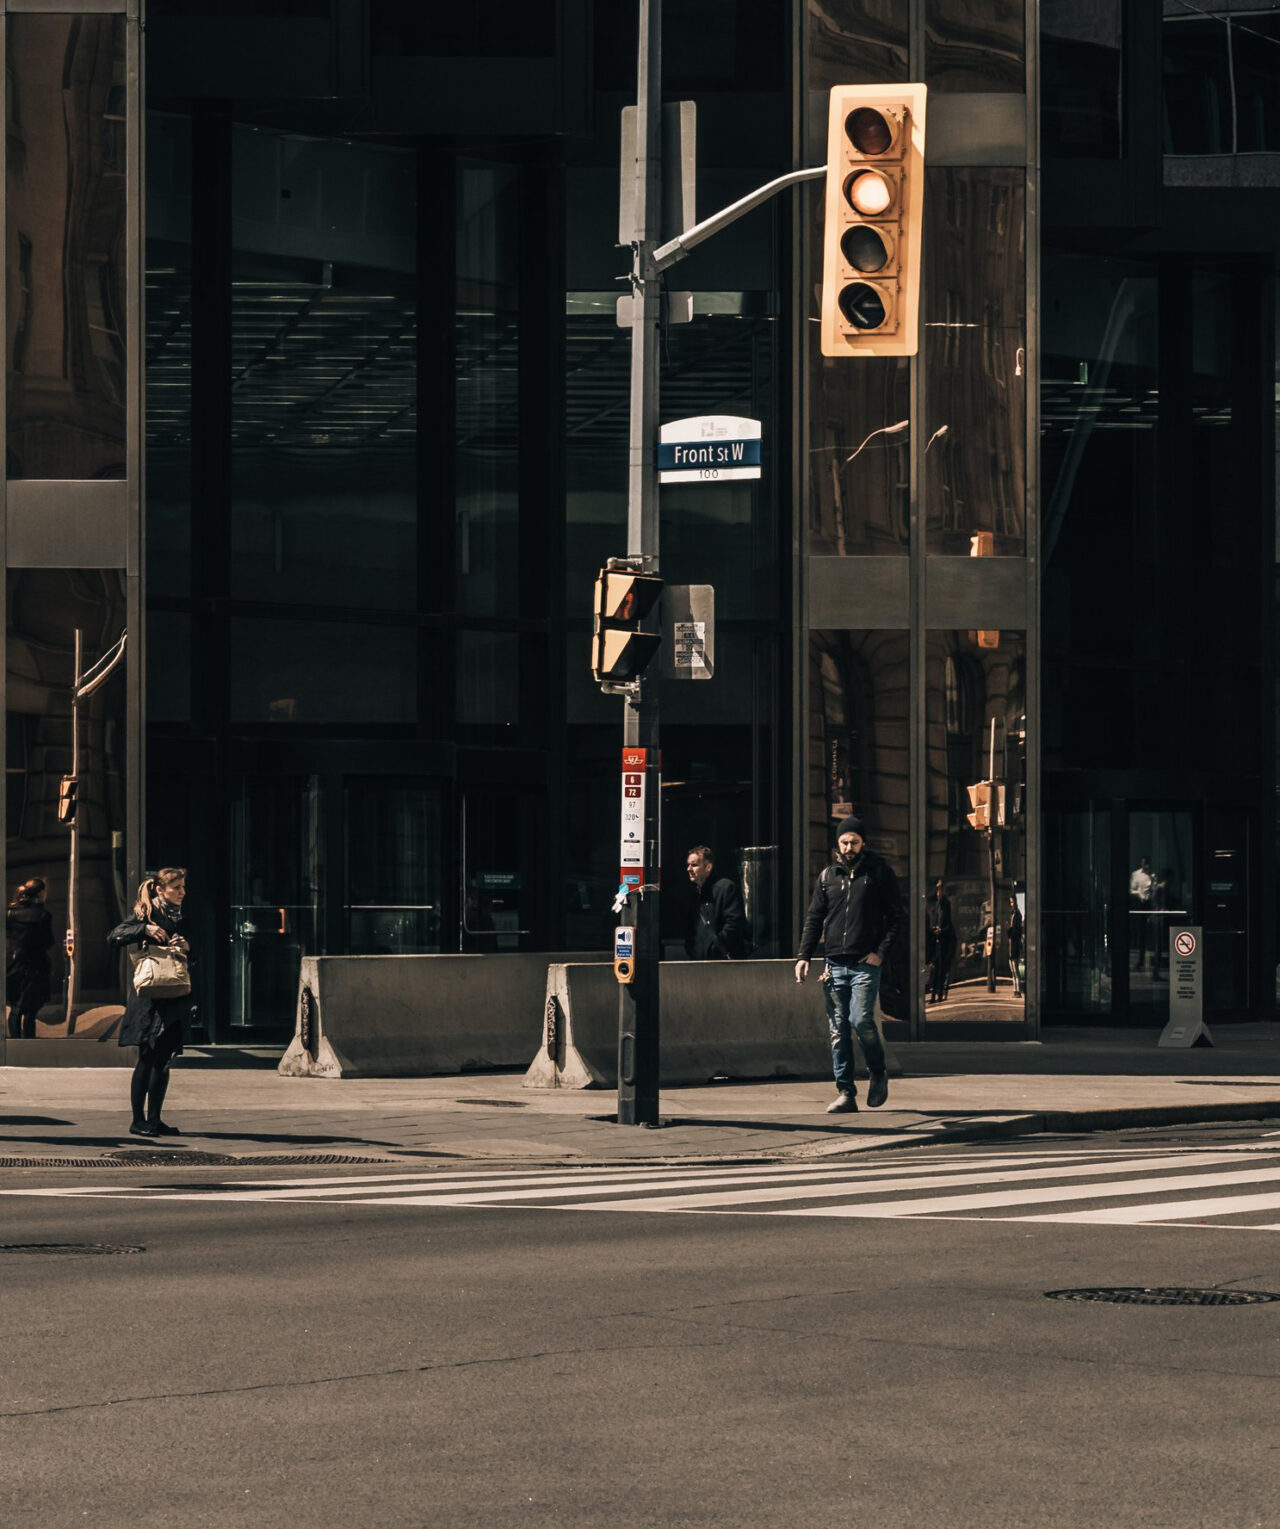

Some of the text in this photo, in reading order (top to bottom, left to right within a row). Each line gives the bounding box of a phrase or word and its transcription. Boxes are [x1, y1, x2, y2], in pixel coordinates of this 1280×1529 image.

[675, 442, 744, 464] Front St W
[699, 468, 719, 479] 100
[630, 775, 635, 784] 6
[628, 788, 637, 796] 72
